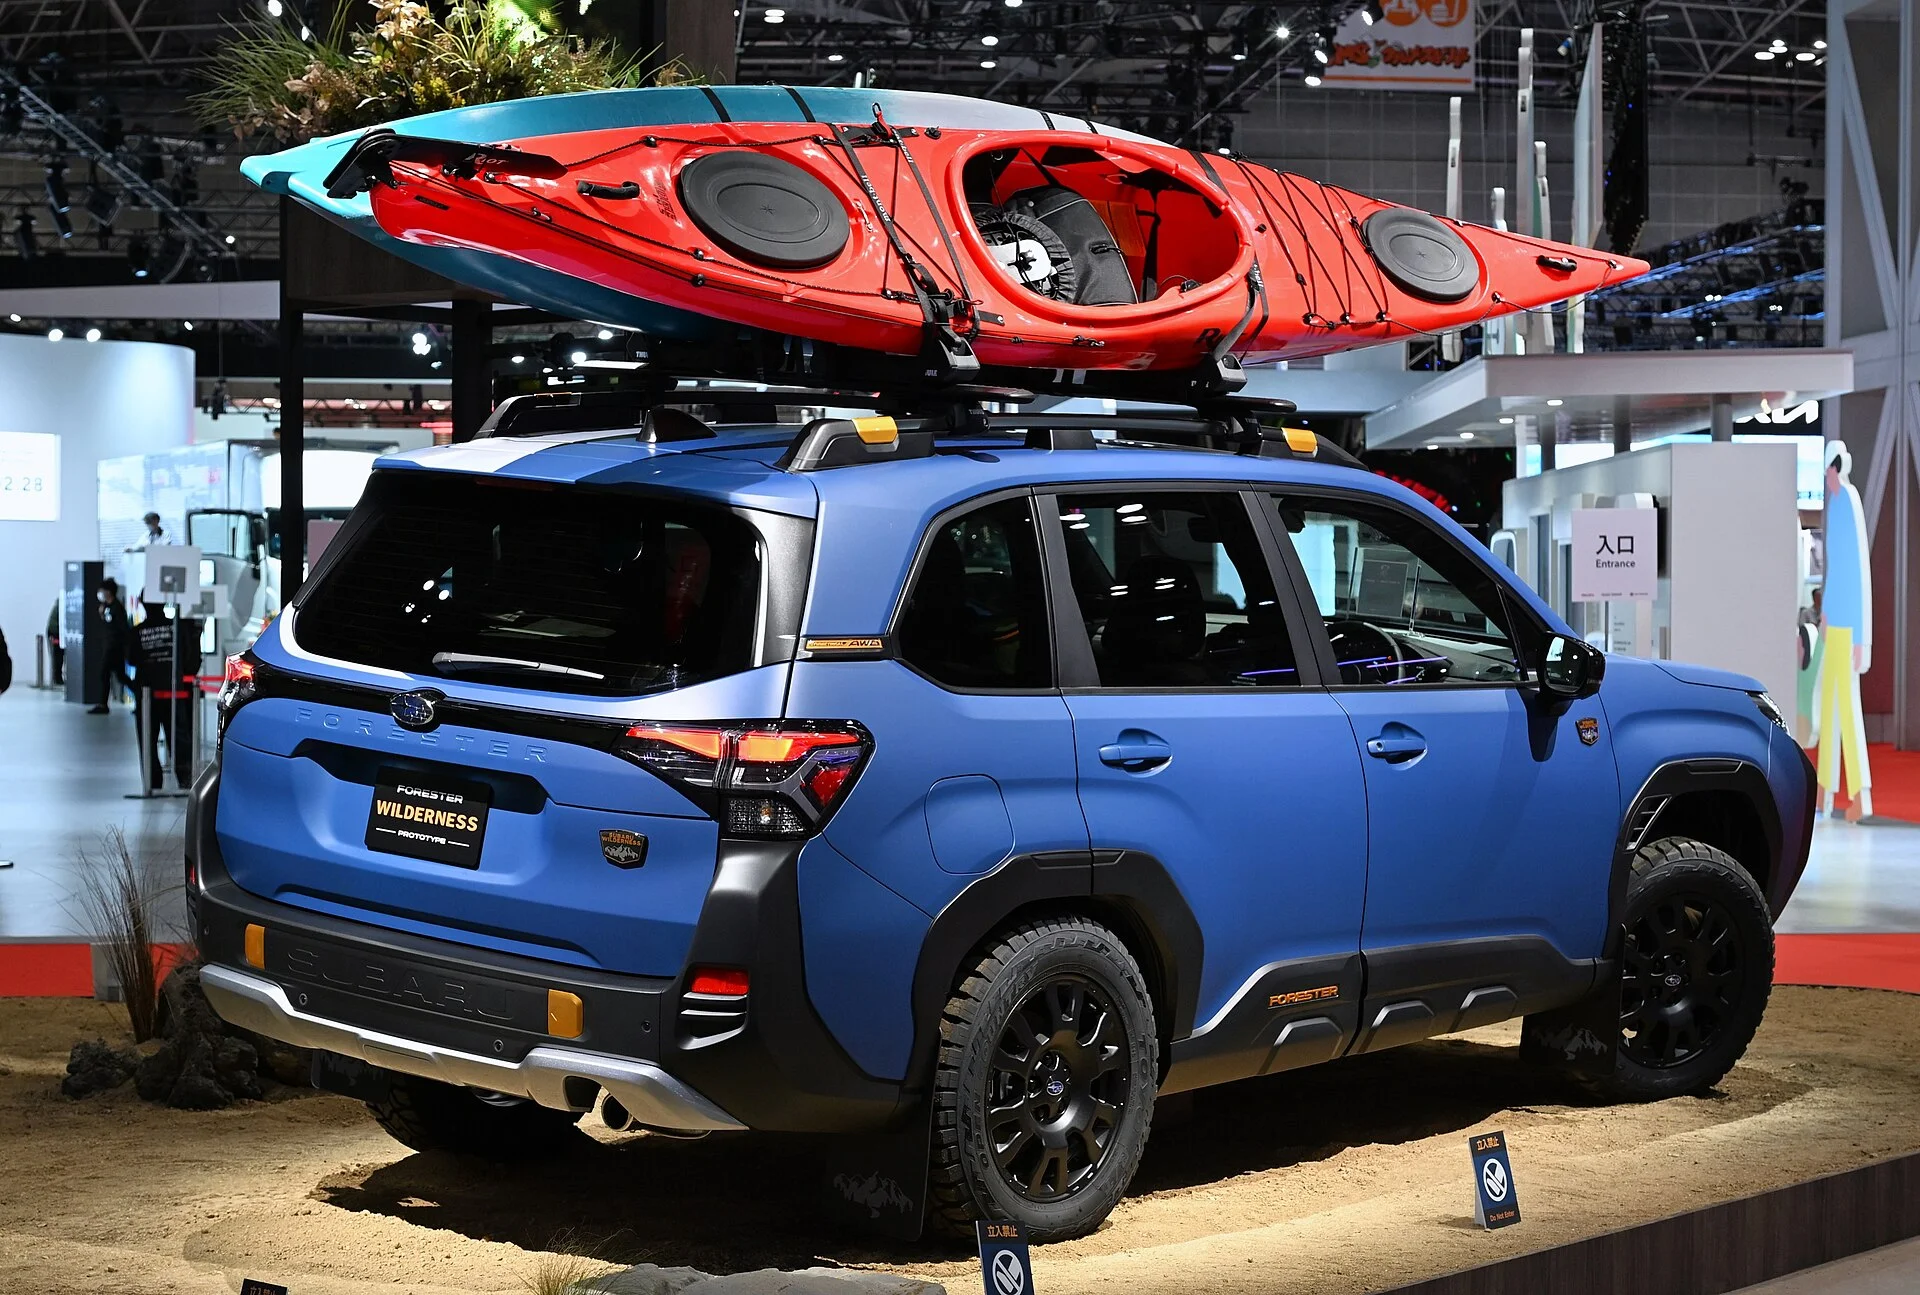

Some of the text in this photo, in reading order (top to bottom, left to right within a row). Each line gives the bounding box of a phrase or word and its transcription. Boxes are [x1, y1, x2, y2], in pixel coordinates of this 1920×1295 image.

[1596, 535, 1634, 555] 入口
[1595, 559, 1636, 568] Entrance
[295, 707, 548, 763] FORESTER
[396, 784, 464, 804] FORESTER
[376, 799, 479, 832] WILDERNESS
[397, 829, 447, 845] PROTOTYPE
[601, 836, 641, 846] WILDERNESS
[608, 832, 635, 841] SUBARU
[288, 948, 517, 1021] SUBARU
[1269, 985, 1339, 1007] FORESTER
[1476, 1136, 1500, 1151] 立入禁止
[1496, 1212, 1505, 1220] Not
[1505, 1210, 1515, 1219] Enter
[987, 1224, 1019, 1238] 立入禁止
